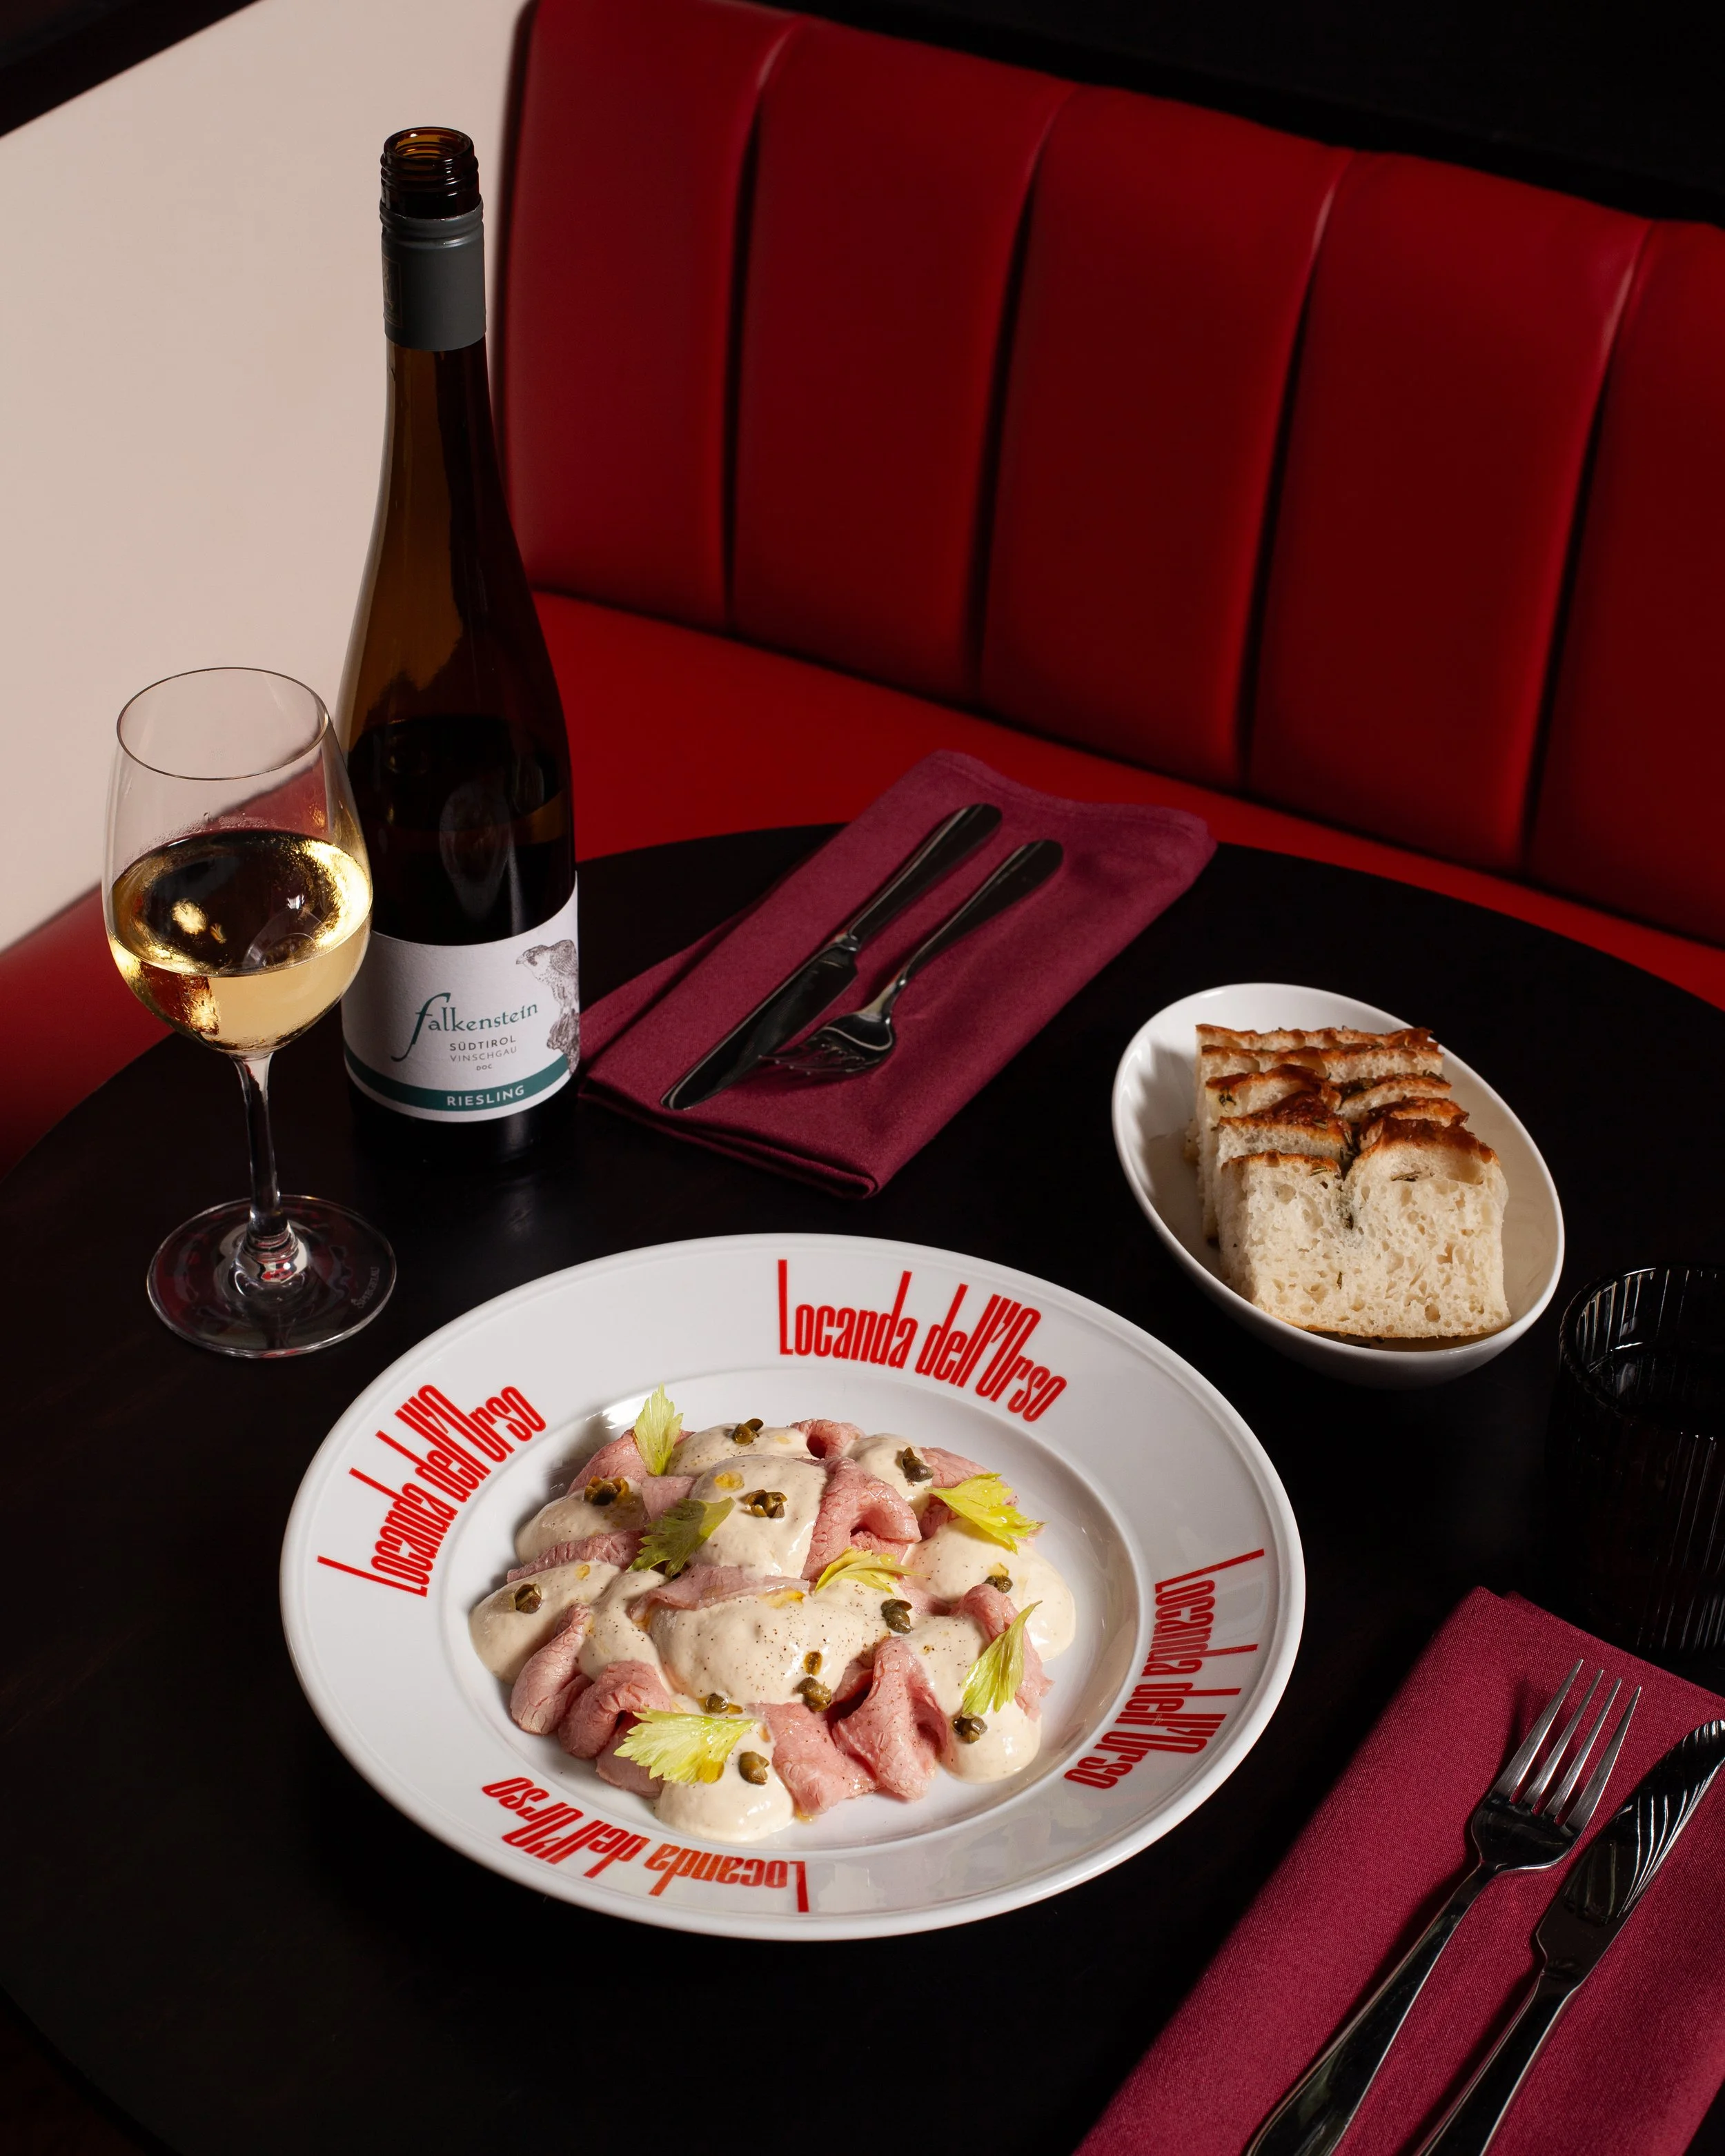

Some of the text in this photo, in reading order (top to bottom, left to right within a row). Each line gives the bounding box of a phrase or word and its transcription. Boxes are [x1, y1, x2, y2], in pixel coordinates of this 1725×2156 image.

[391, 992, 539, 1062] falkenstein
[449, 1035, 517, 1052] SÜDTIROL
[450, 1046, 518, 1062] VINSCHGAU
[446, 1085, 525, 1107] RIESLING
[778, 1259, 1067, 1423] Locanda dell'Orso
[317, 1385, 546, 1597] Locanda dell'Orso
[1063, 1548, 1265, 1790] Locanda dell'Orso
[481, 1777, 809, 1913] Locanda dell'Orso
